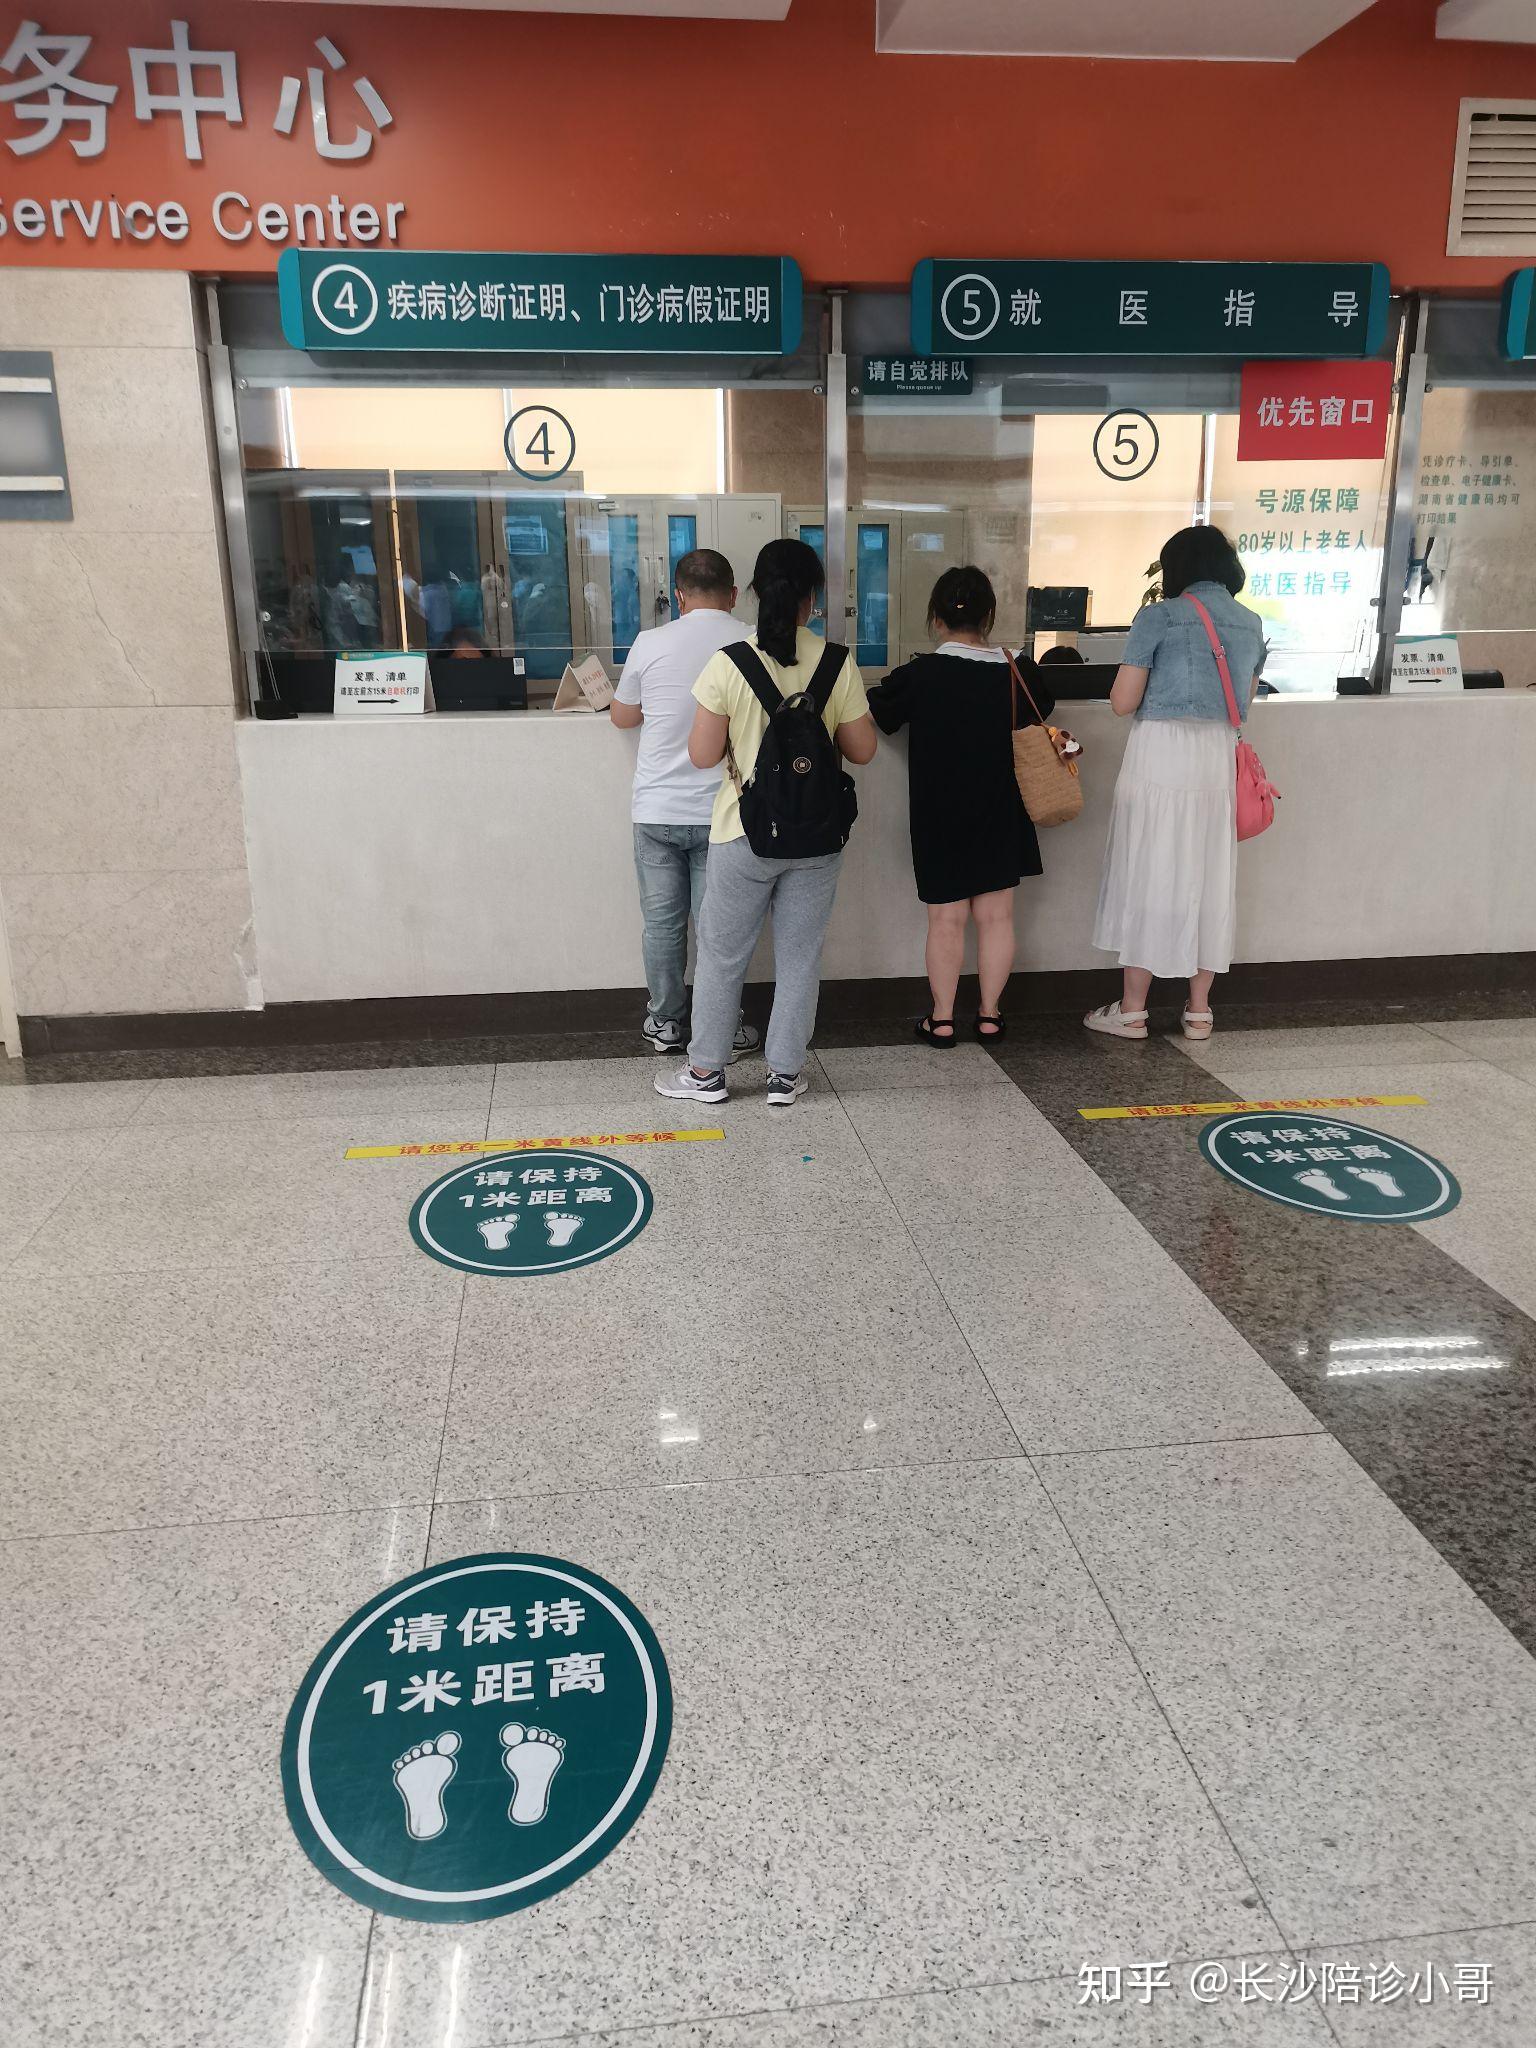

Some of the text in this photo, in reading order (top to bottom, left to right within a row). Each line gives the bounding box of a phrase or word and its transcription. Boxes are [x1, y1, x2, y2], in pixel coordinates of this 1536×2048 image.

[0, 19, 393, 160] 务中心
[212, 191, 405, 242] Center
[388, 280, 770, 324] 疾病诊断证明、门诊病假证明
[867, 360, 969, 381] 请自觉排队
[1257, 396, 1374, 427] 优先窗口
[1255, 488, 1360, 513] 号源保障
[1237, 529, 1367, 554] 80岁以上老年人
[1249, 569, 1352, 597] 就医指导
[1401, 653, 1444, 663] 发票、清单
[354, 671, 407, 682] 发票、清单
[1127, 1096, 1386, 1117] 请您在一米黄线外等候
[400, 1131, 677, 1155] 请您在一米黄线外等候
[1230, 1126, 1355, 1146] 请保持
[1241, 1144, 1393, 1165] 1米距离
[473, 1167, 603, 1187] 请保持
[457, 1187, 614, 1208] 1米距离
[386, 1598, 586, 1655] 请保持
[362, 1652, 605, 1715] 1米距离
